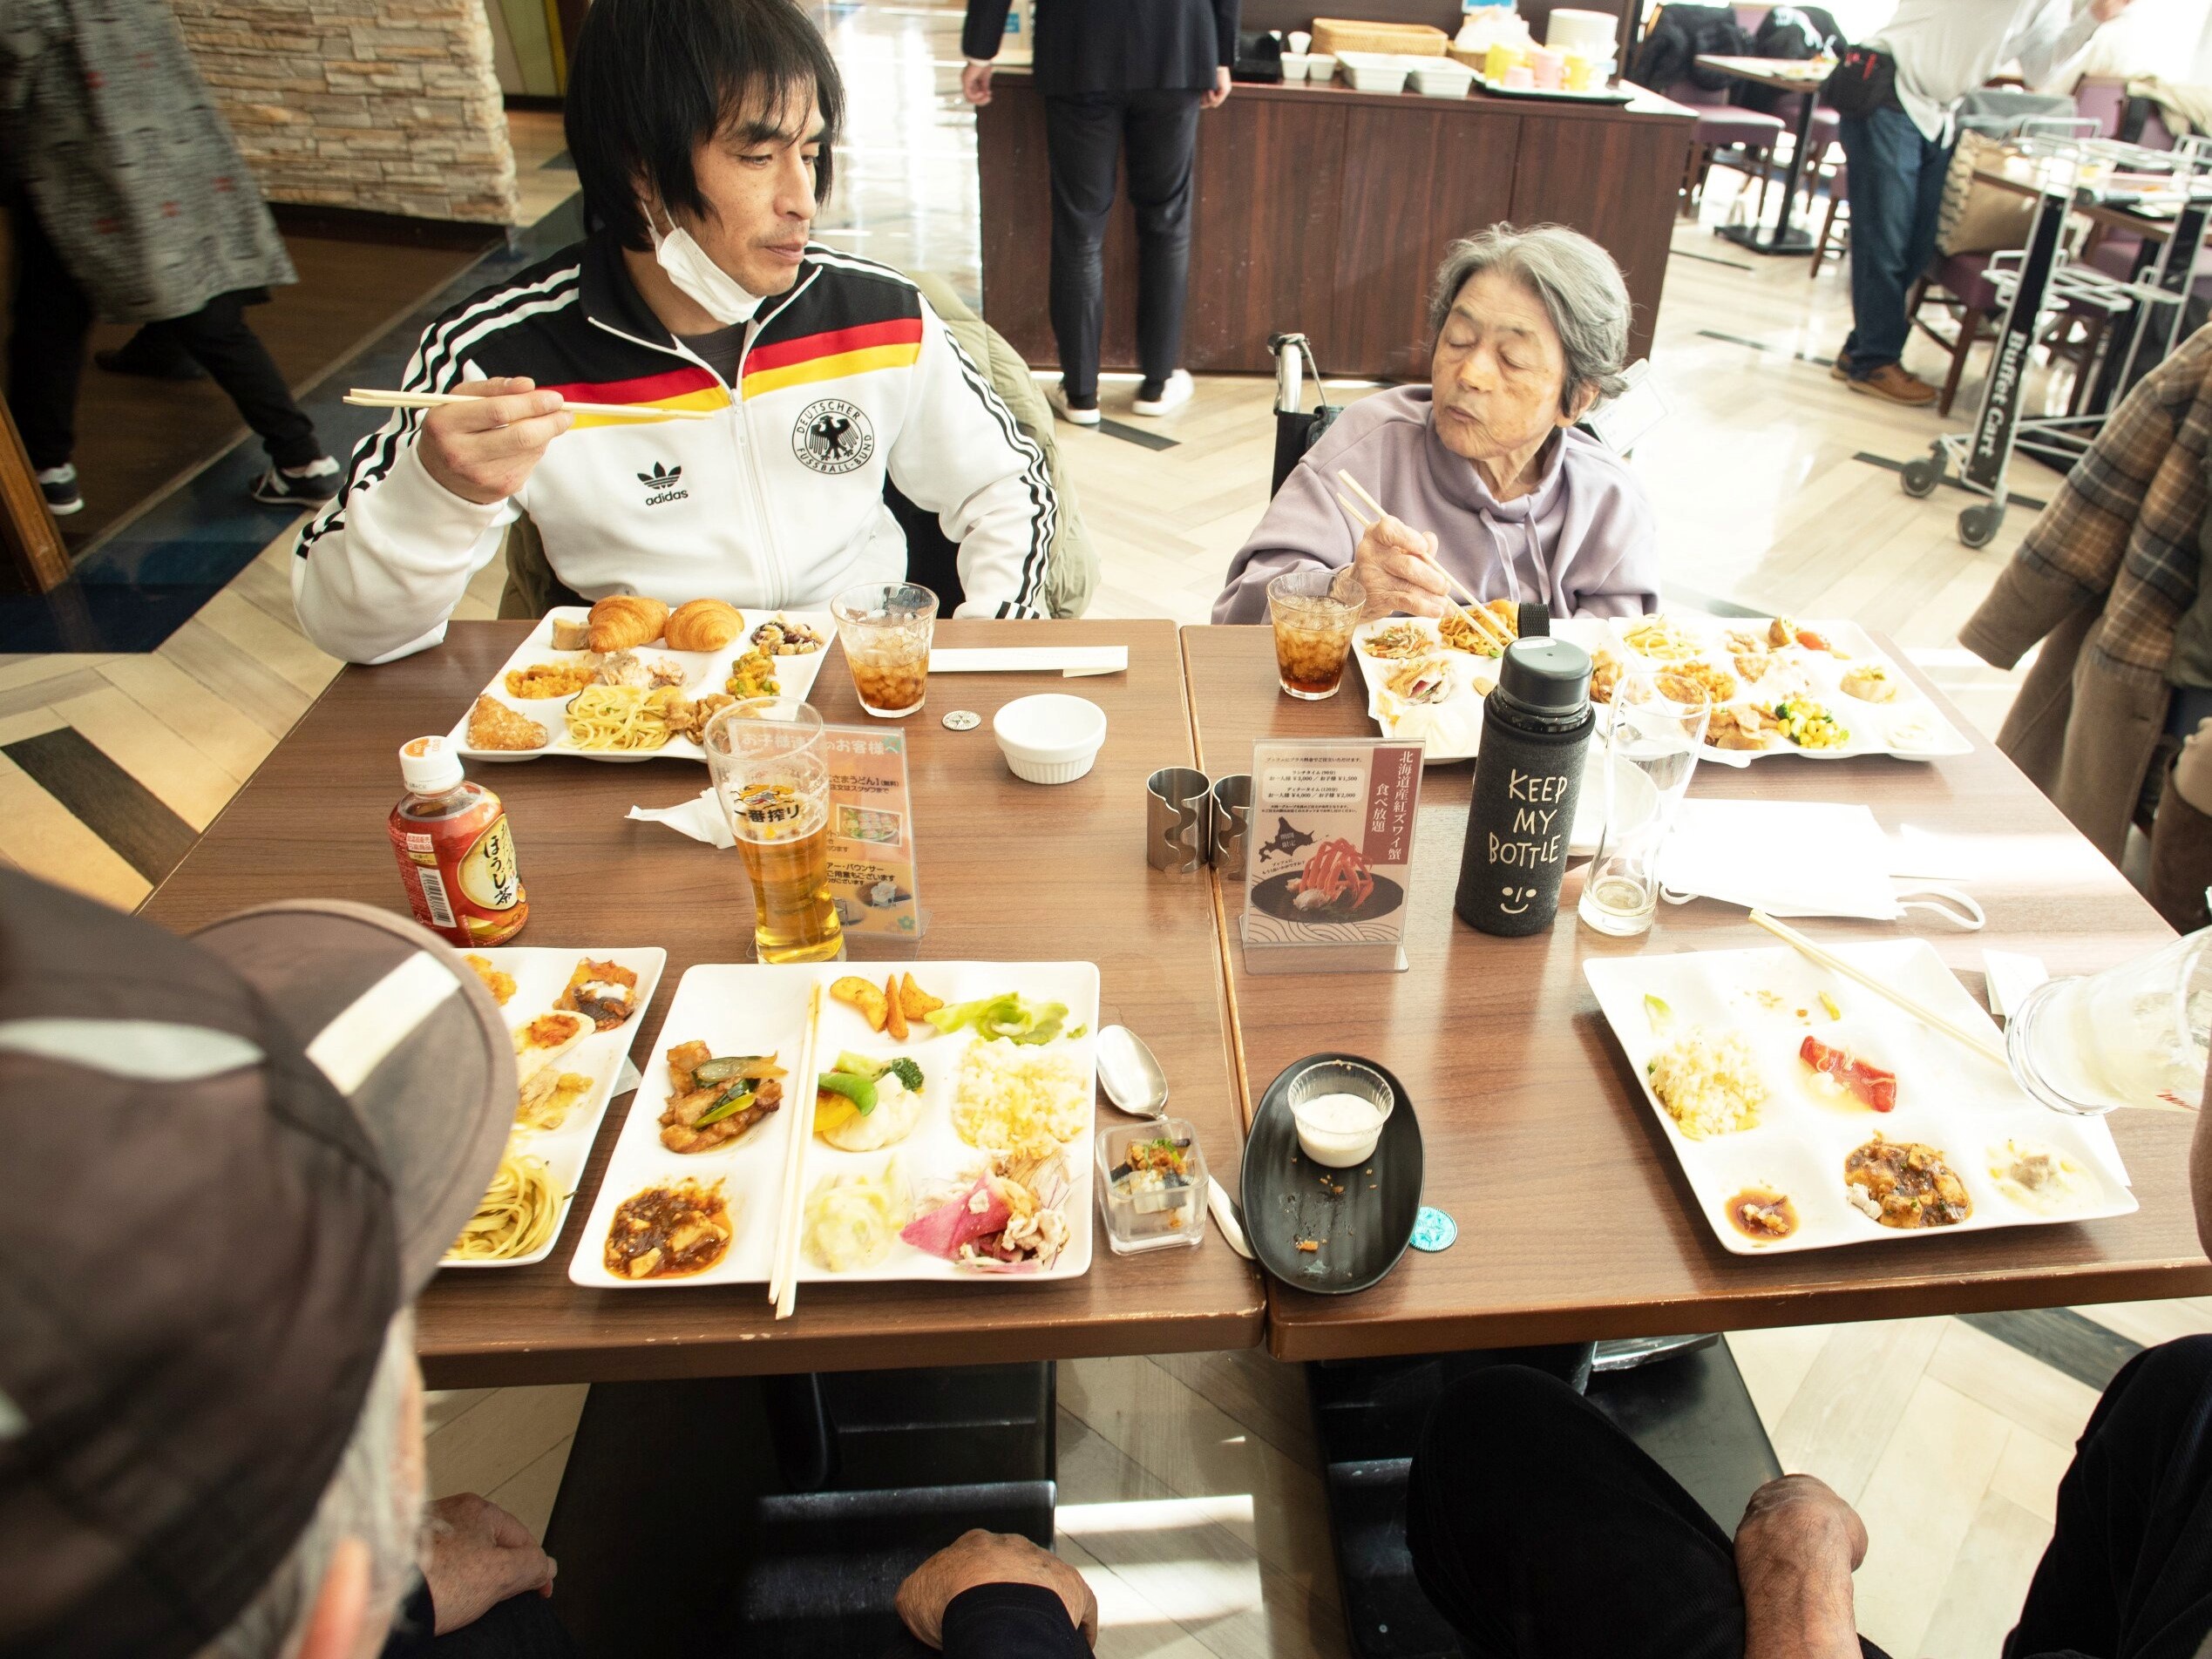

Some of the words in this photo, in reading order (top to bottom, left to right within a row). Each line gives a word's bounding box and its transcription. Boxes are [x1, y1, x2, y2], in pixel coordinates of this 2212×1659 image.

[1991, 329, 2027, 405] Buffet
[797, 402, 860, 434] DEUTSCHER
[1980, 409, 2005, 457] Cart
[796, 434, 872, 473] FUSSBALL-BUND
[645, 489, 689, 506] adidas
[1388, 750, 1414, 861] 北海道産紅ズワイ蟹
[1509, 769, 1568, 804] KEEP
[734, 803, 800, 823] 一番搾り
[1372, 782, 1389, 833] 食べ放題
[1513, 809, 1557, 836] MY
[1489, 831, 1562, 869] BOTTLE
[483, 835, 512, 906] ほうじ茶
